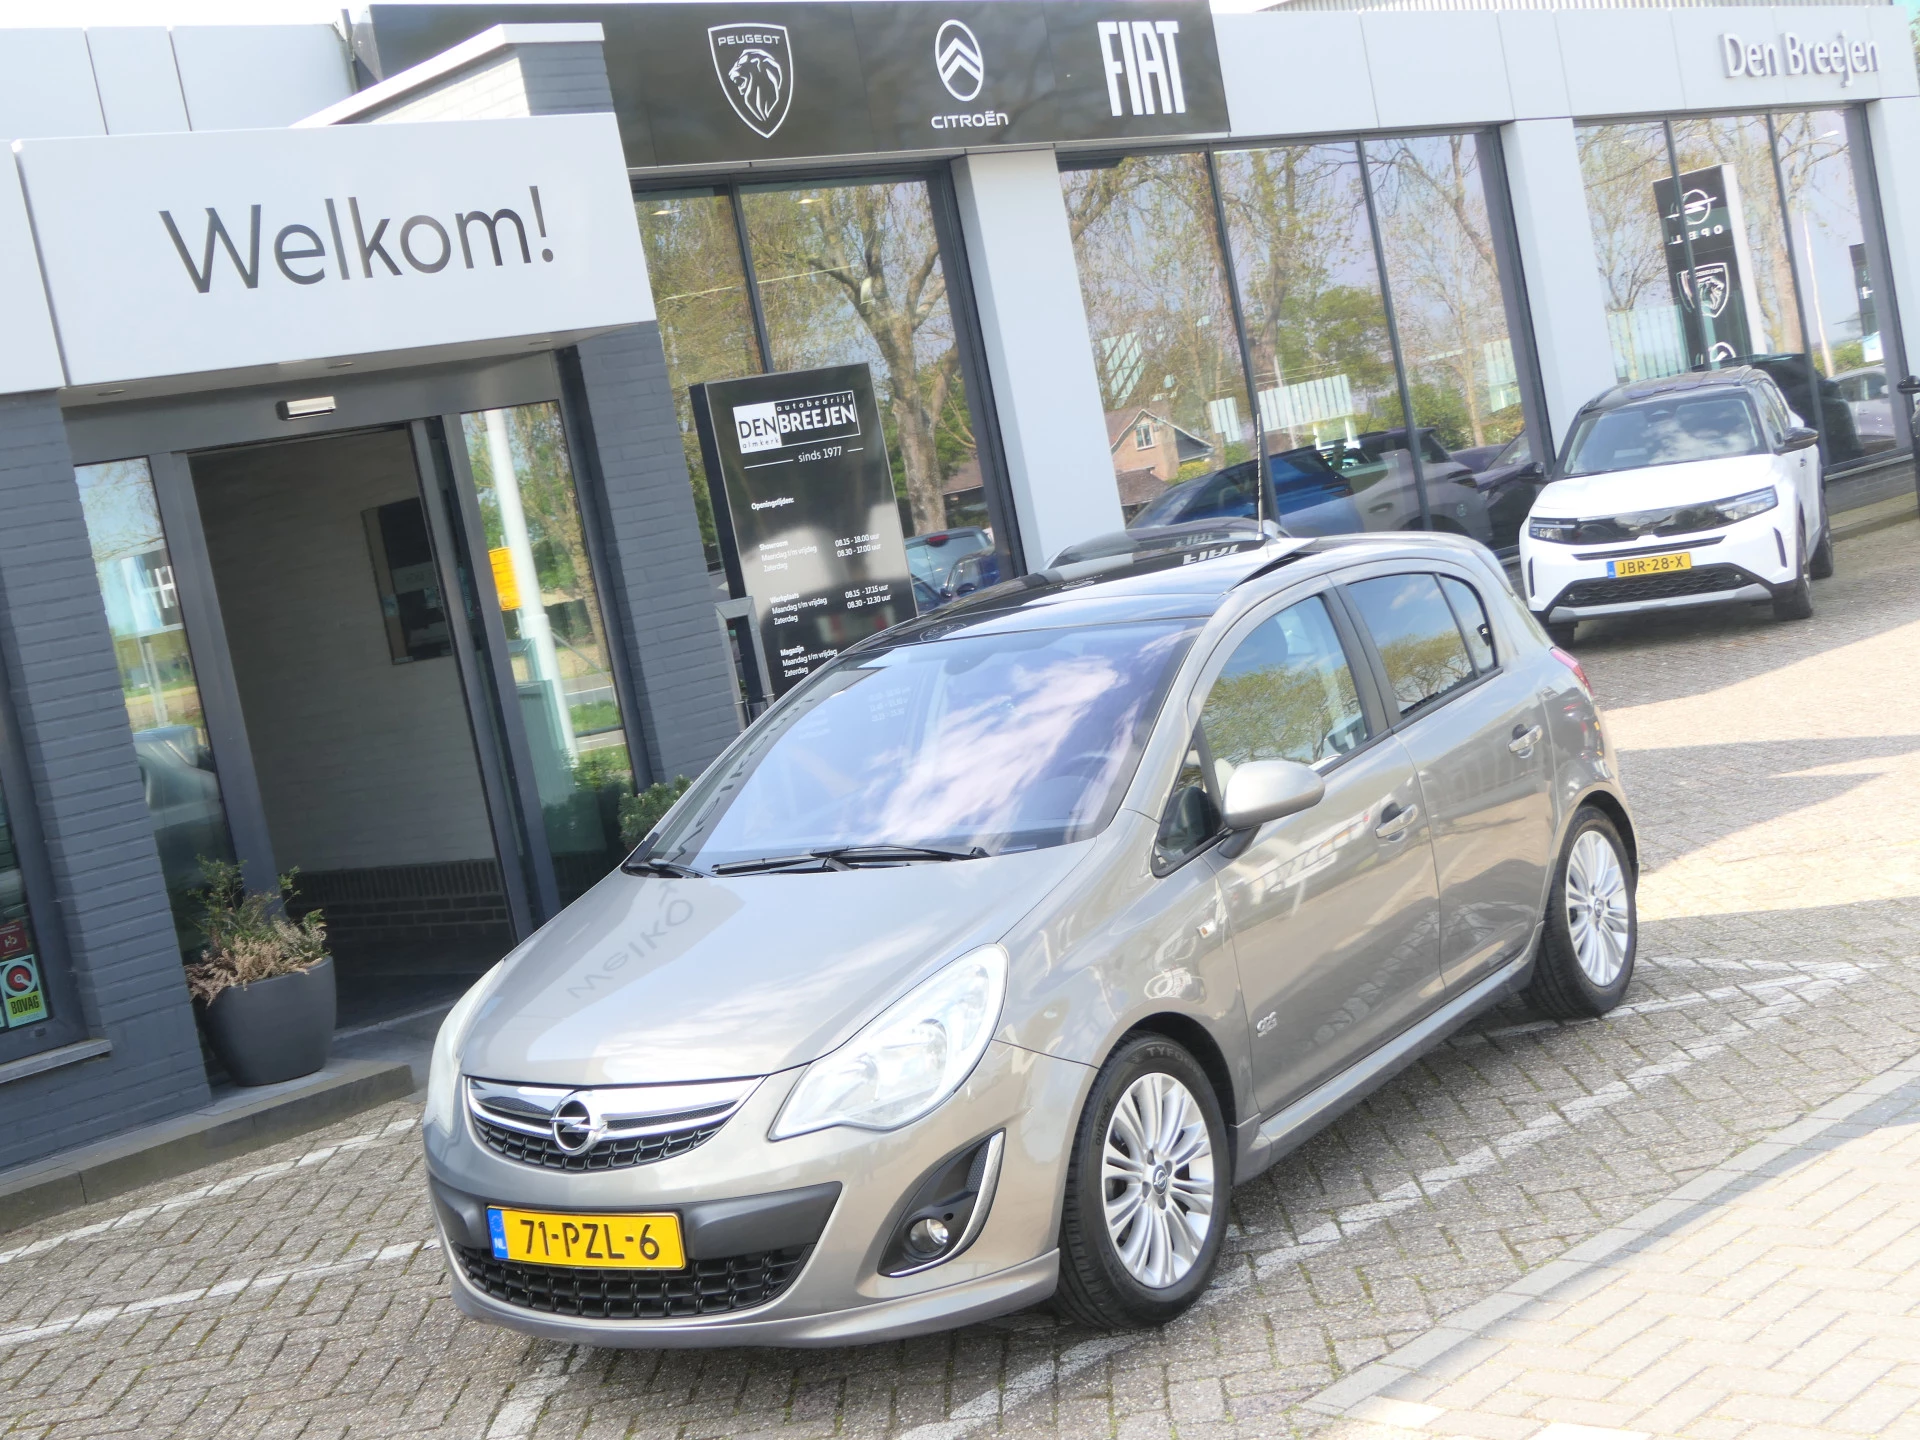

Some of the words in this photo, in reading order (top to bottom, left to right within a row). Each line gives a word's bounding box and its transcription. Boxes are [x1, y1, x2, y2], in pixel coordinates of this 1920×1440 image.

[717, 34, 780, 46] PEUGEOT
[1097, 20, 1186, 117] FIAT
[1718, 32, 1780, 79] Den
[1780, 30, 1881, 88] Breejen
[158, 185, 554, 294] Welkom!
[776, 394, 852, 412] autobedrijf
[738, 415, 778, 439] DEN
[778, 404, 856, 434] BREEJEN
[742, 437, 780, 449] almkerk
[798, 449, 821, 463] sinds
[823, 446, 842, 459] 1977
[1620, 556, 1683, 575] JBR-28-X
[10, 995, 40, 1014] BOVAG
[494, 1238, 507, 1250] NL
[520, 1219, 660, 1260] 71-PZL-6
